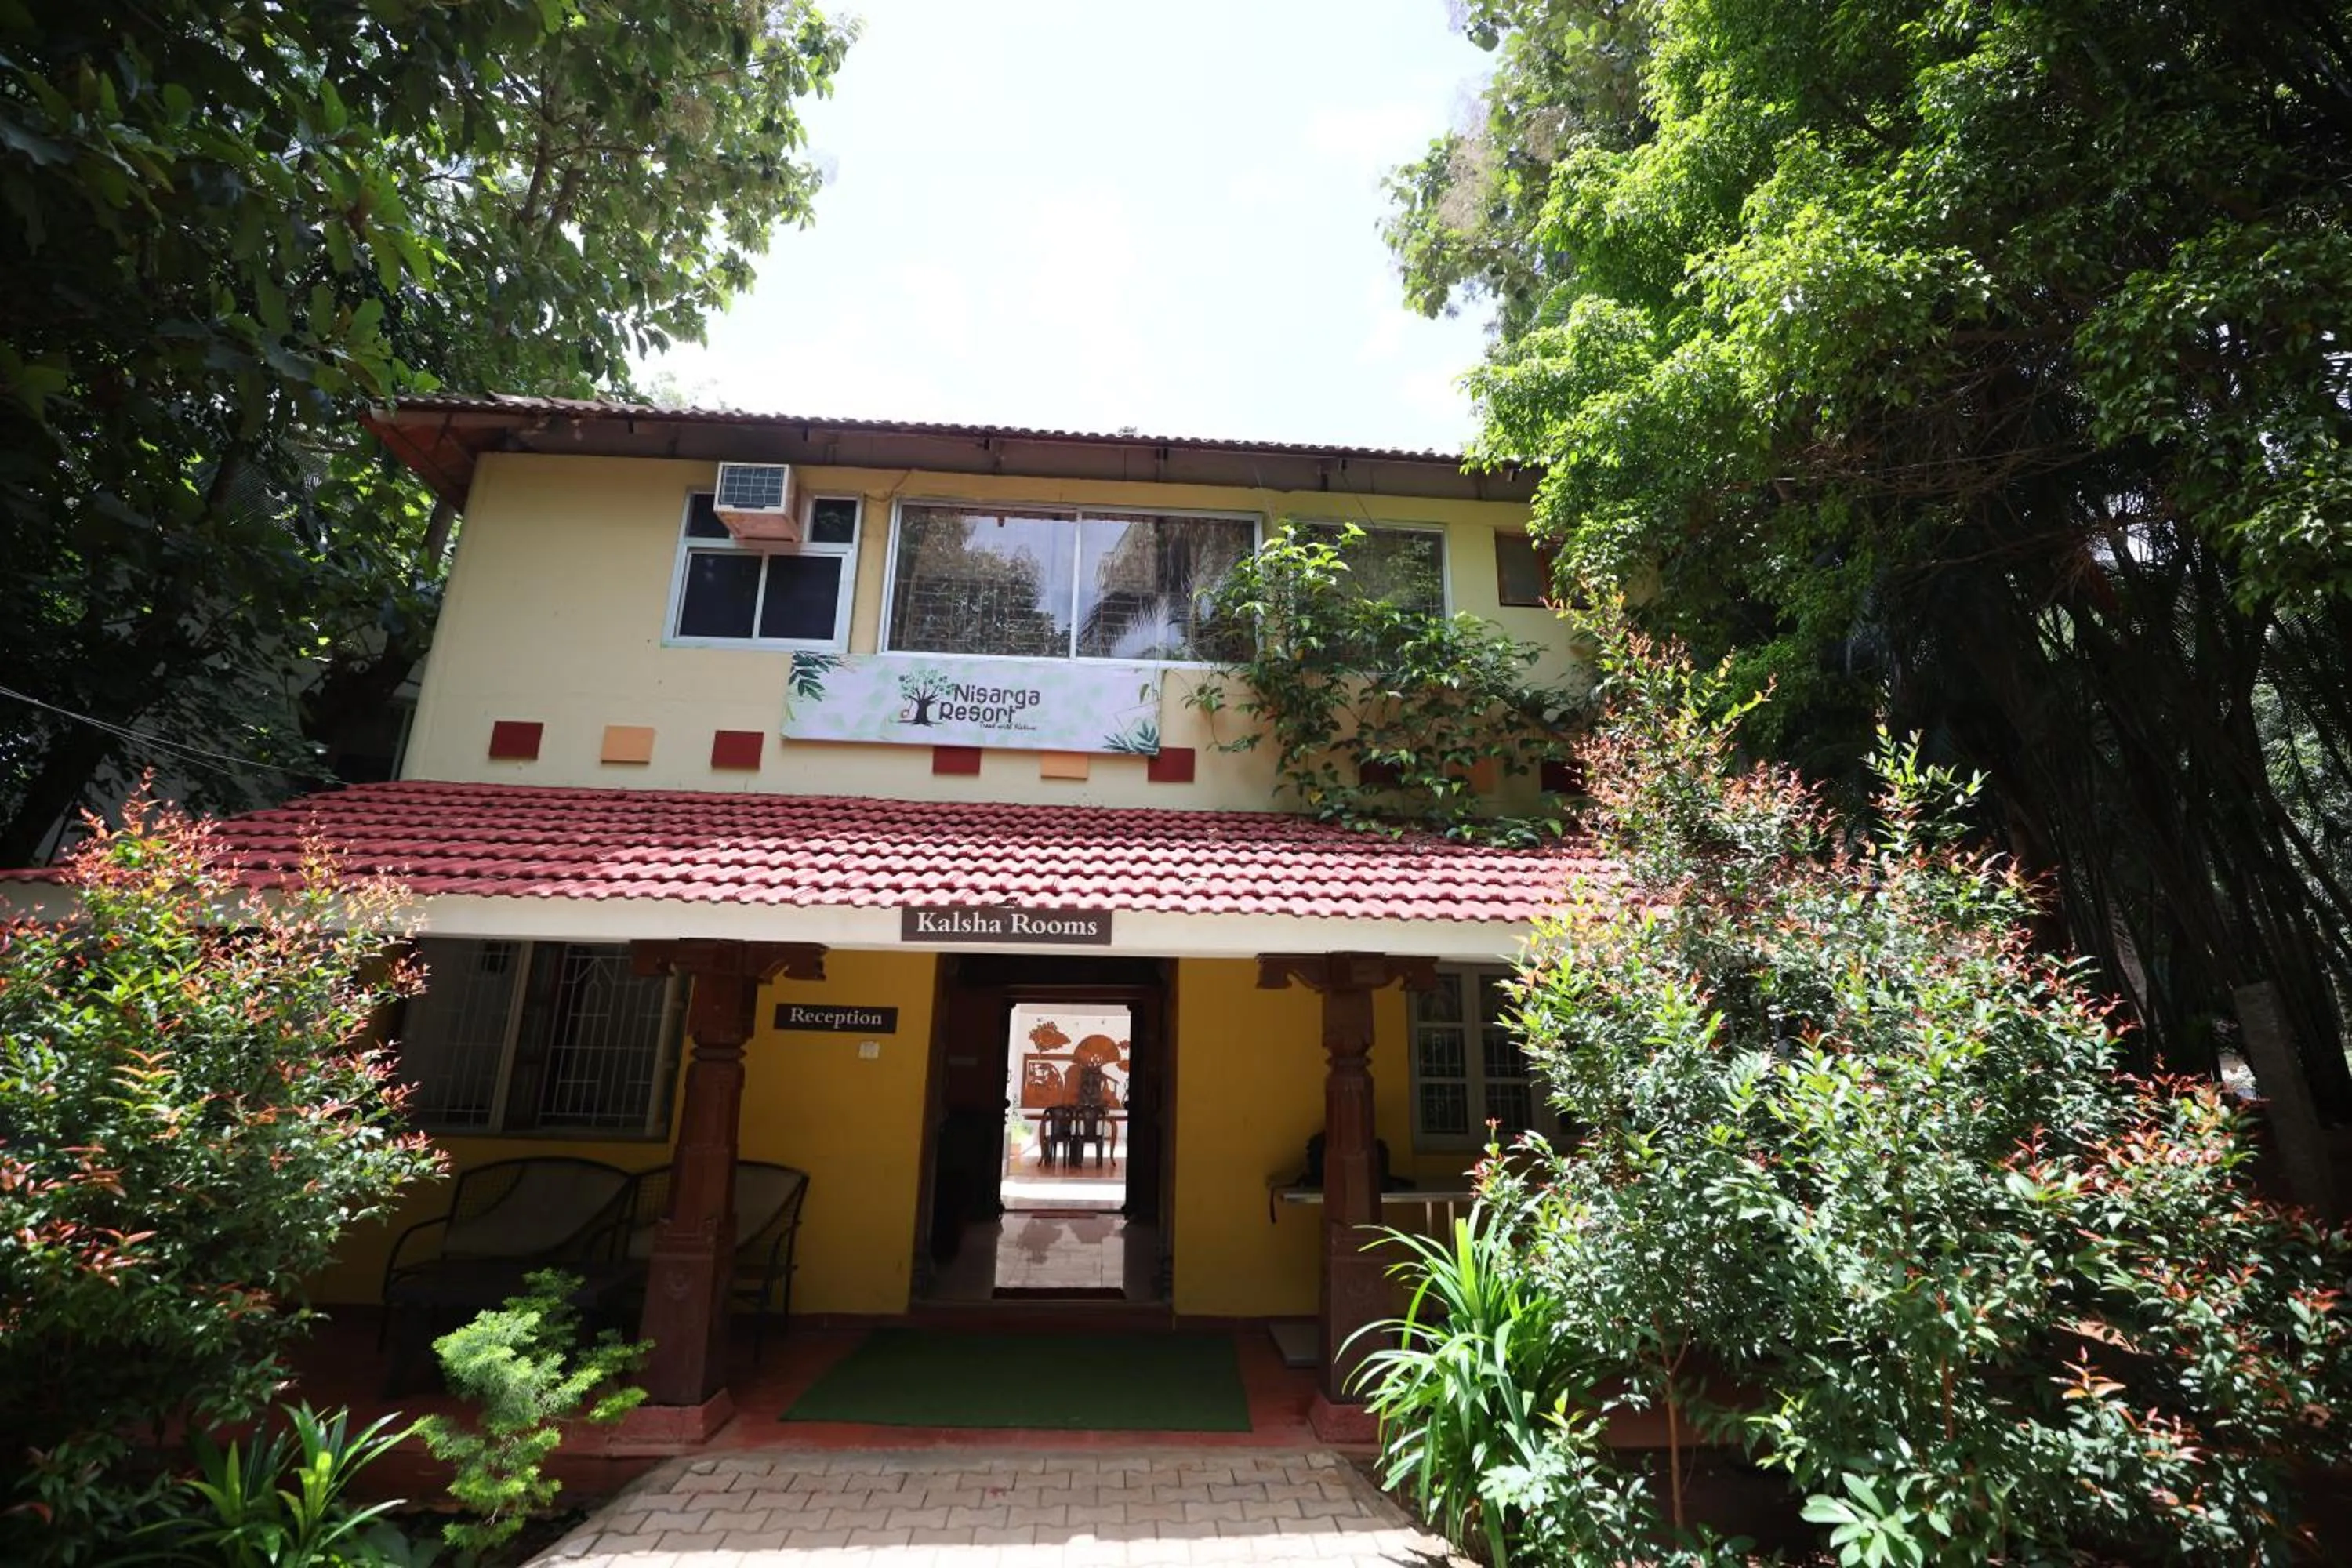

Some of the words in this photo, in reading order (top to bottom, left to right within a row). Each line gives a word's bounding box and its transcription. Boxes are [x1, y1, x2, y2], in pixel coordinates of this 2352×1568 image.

[954, 684, 1040, 709] Nisarga
[938, 702, 1015, 722] Resort
[916, 911, 1002, 933] Kalsha
[1011, 913, 1098, 935] Rooms
[789, 1007, 882, 1029] Reception
